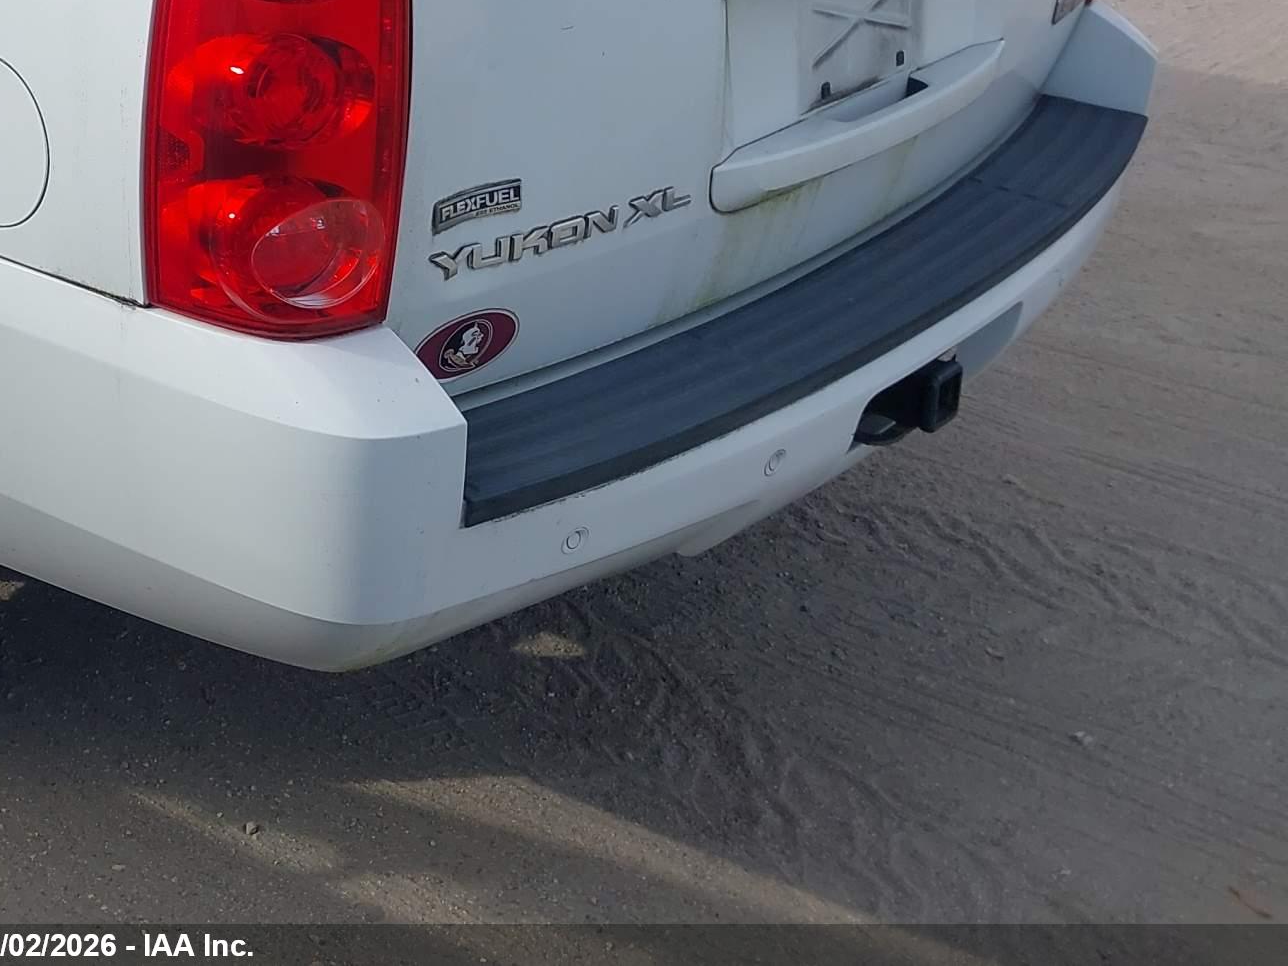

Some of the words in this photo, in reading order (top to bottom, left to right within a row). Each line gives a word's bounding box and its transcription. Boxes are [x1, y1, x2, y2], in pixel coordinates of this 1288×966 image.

[429, 205, 619, 281] YUKON
[623, 185, 692, 229] XL
[440, 187, 520, 222] FLEXFUEL
